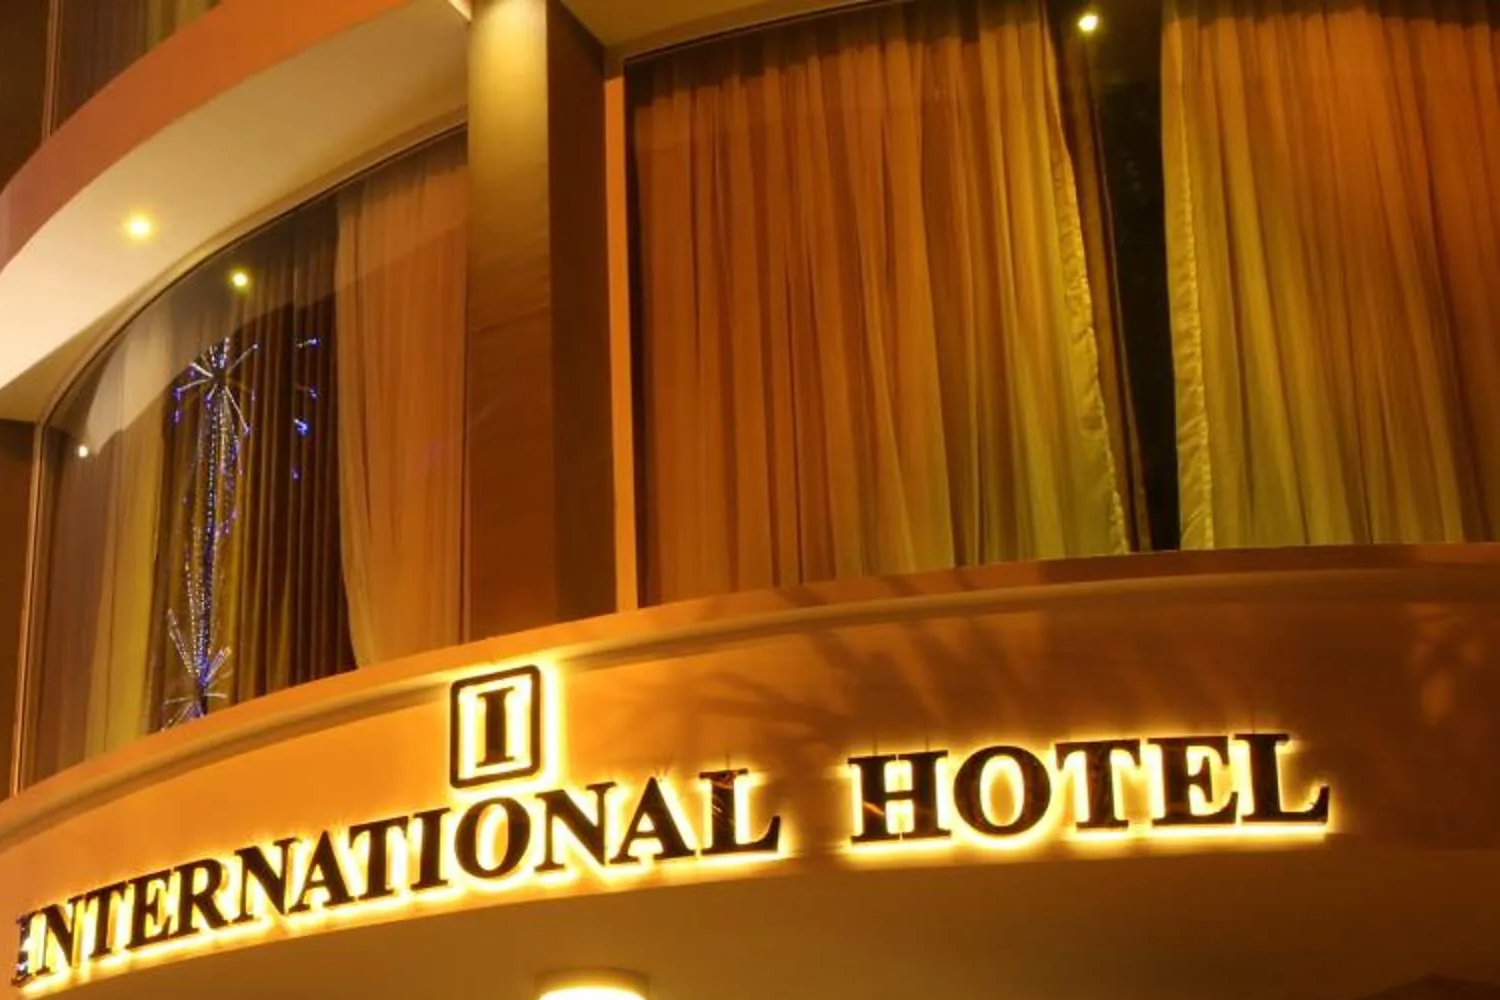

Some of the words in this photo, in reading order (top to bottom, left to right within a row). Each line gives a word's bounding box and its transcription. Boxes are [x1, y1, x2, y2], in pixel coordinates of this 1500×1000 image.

[475, 686, 517, 768] I
[11, 768, 781, 988] INTERNATIONAL
[847, 732, 1330, 845] HOTEL
